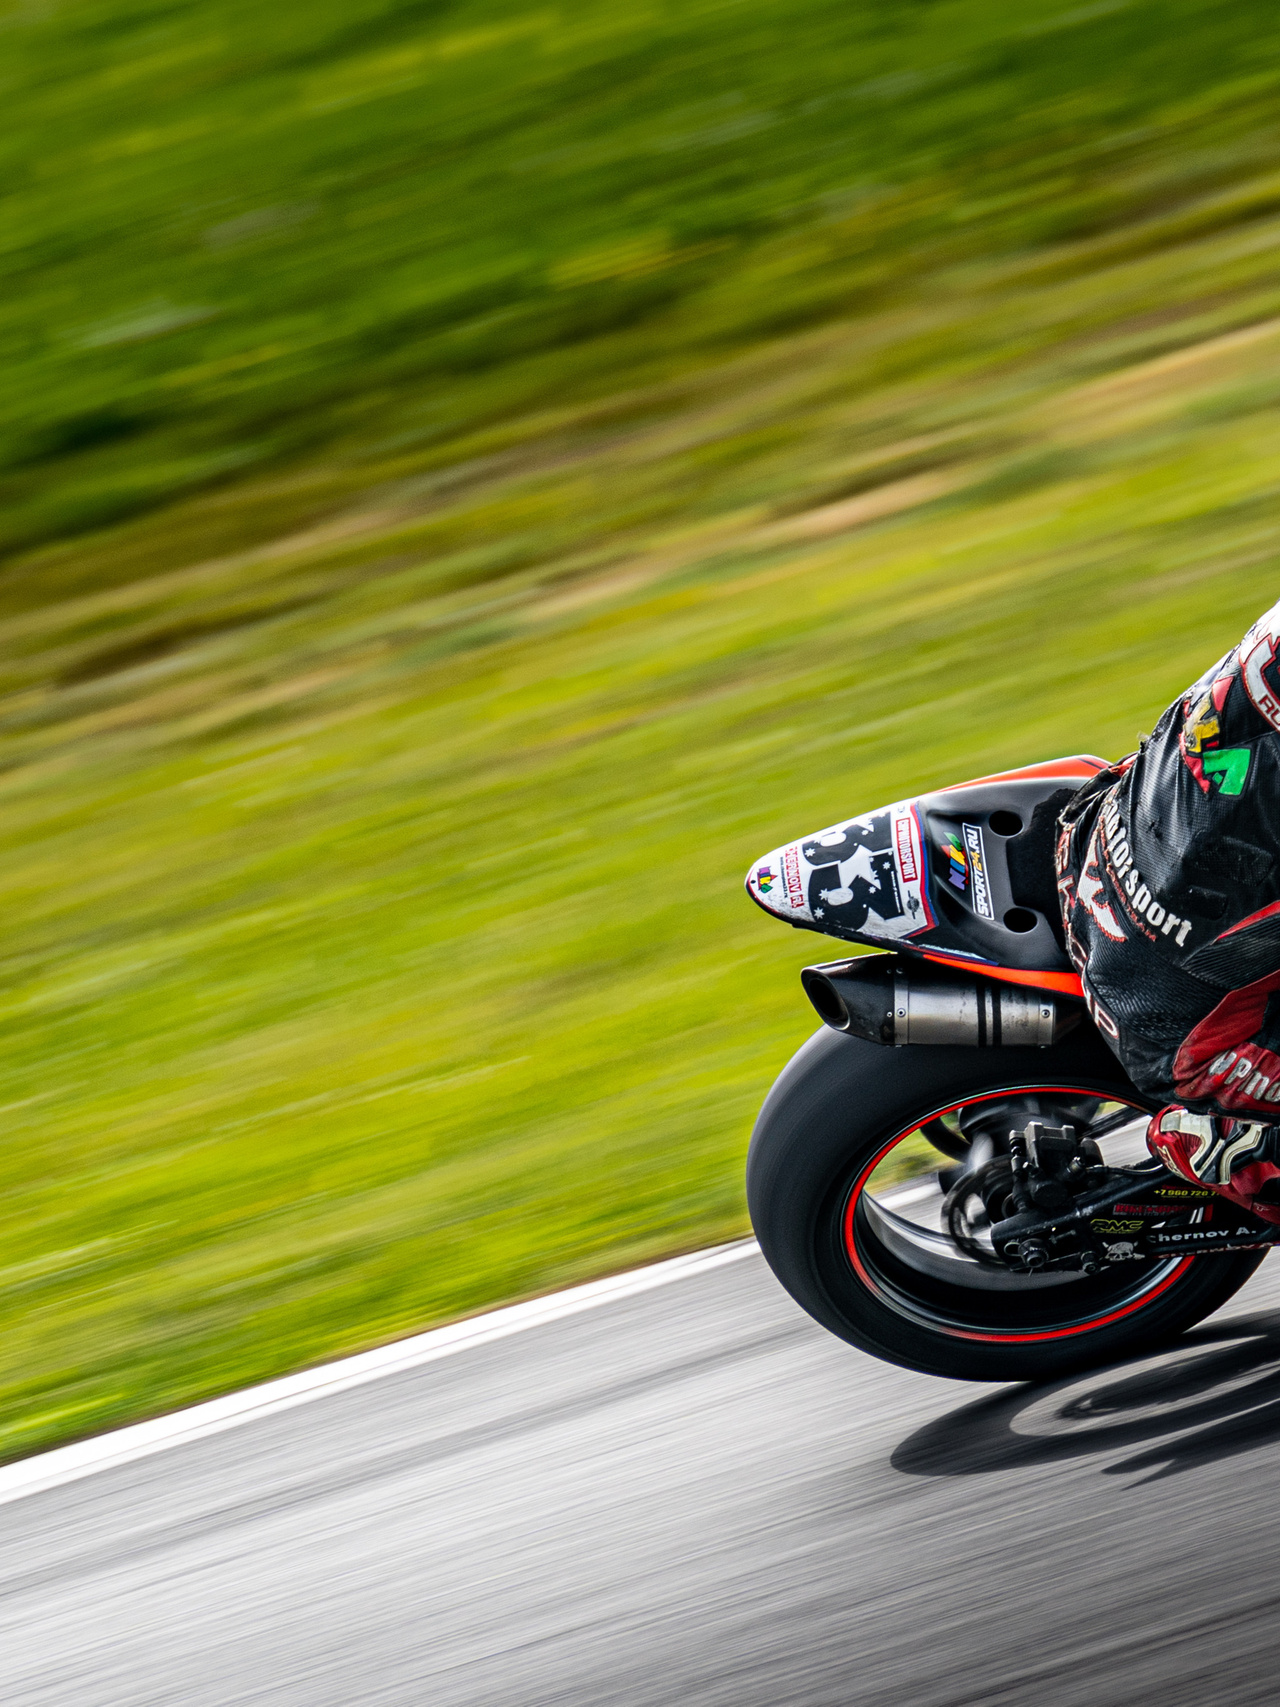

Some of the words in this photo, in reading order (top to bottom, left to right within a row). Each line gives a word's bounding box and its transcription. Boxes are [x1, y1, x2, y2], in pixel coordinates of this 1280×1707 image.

[897, 819, 916, 880] CHPMOTORSPORT
[967, 829, 990, 917] SPORT24.RU
[1147, 1230, 1229, 1243] Chernov
[1236, 1227, 1257, 1236] A.
